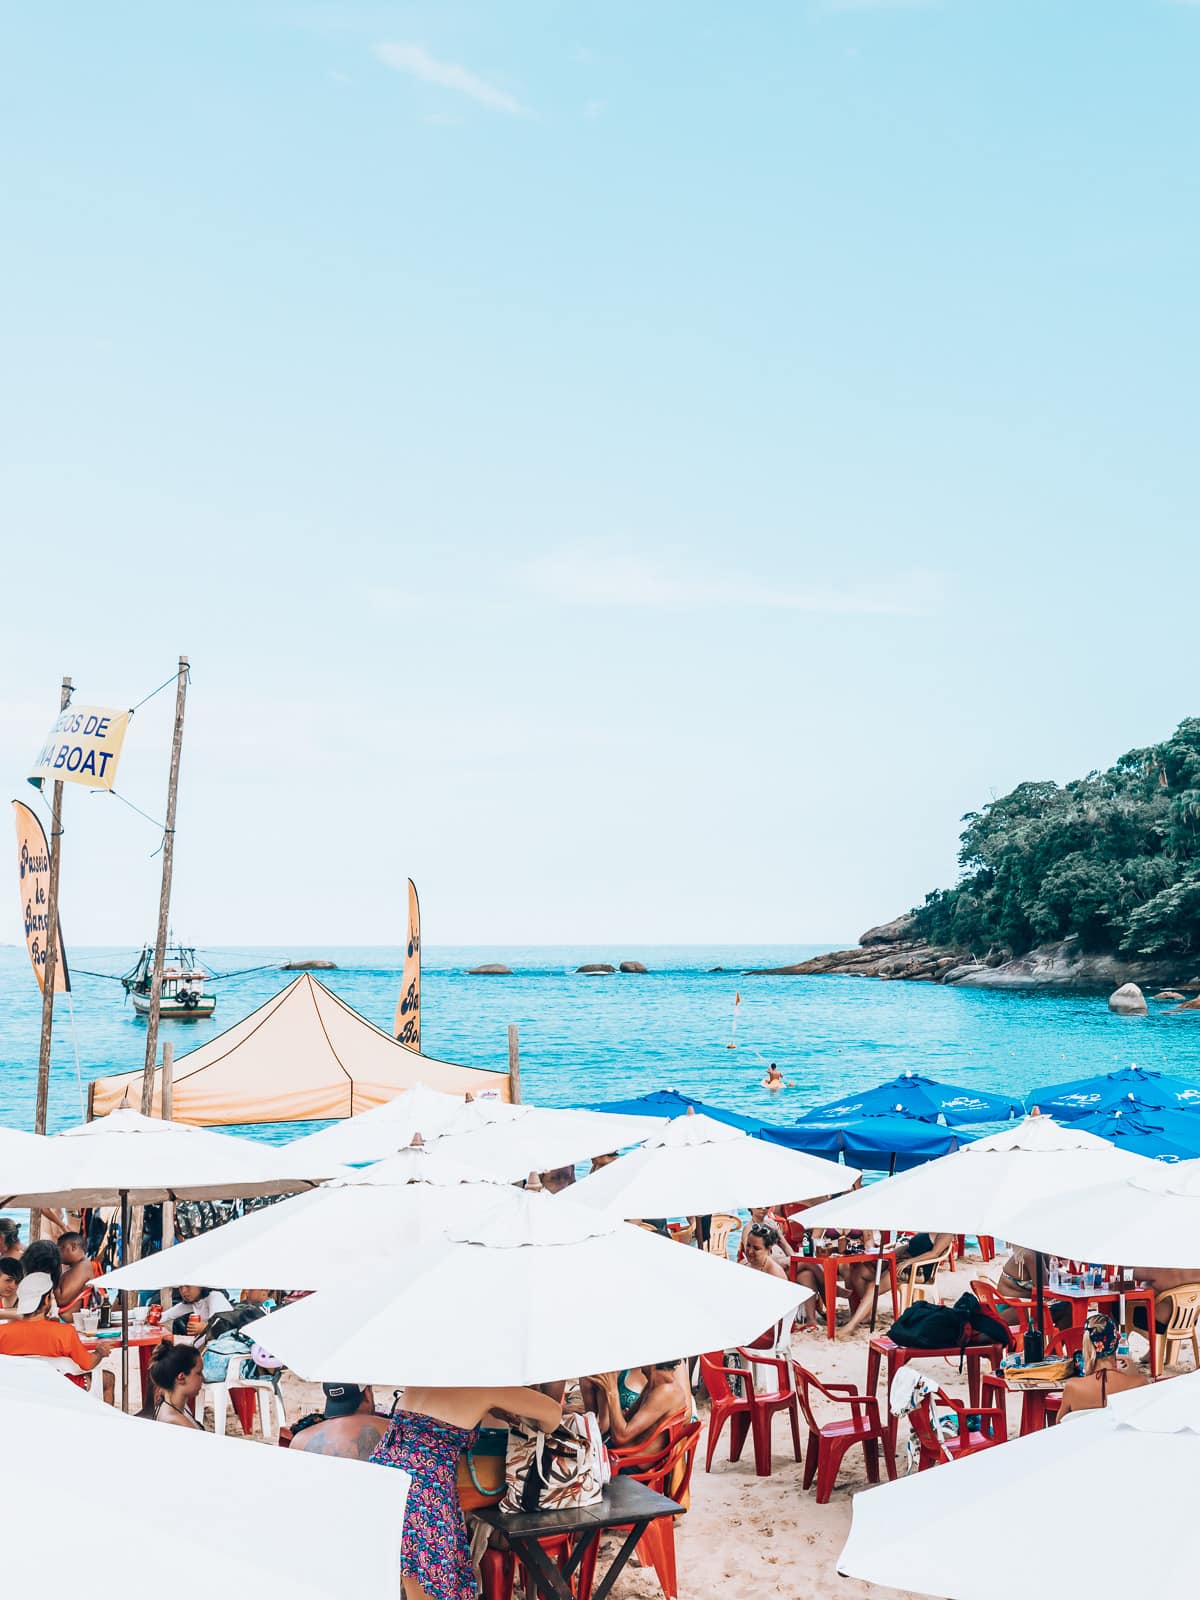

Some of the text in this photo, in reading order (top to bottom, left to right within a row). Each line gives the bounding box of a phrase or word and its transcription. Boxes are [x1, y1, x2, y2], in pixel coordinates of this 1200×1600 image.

[83, 716, 111, 738] DE
[53, 744, 113, 778] BOAT
[20, 839, 48, 880] Passeio
[35, 878, 46, 905] de
